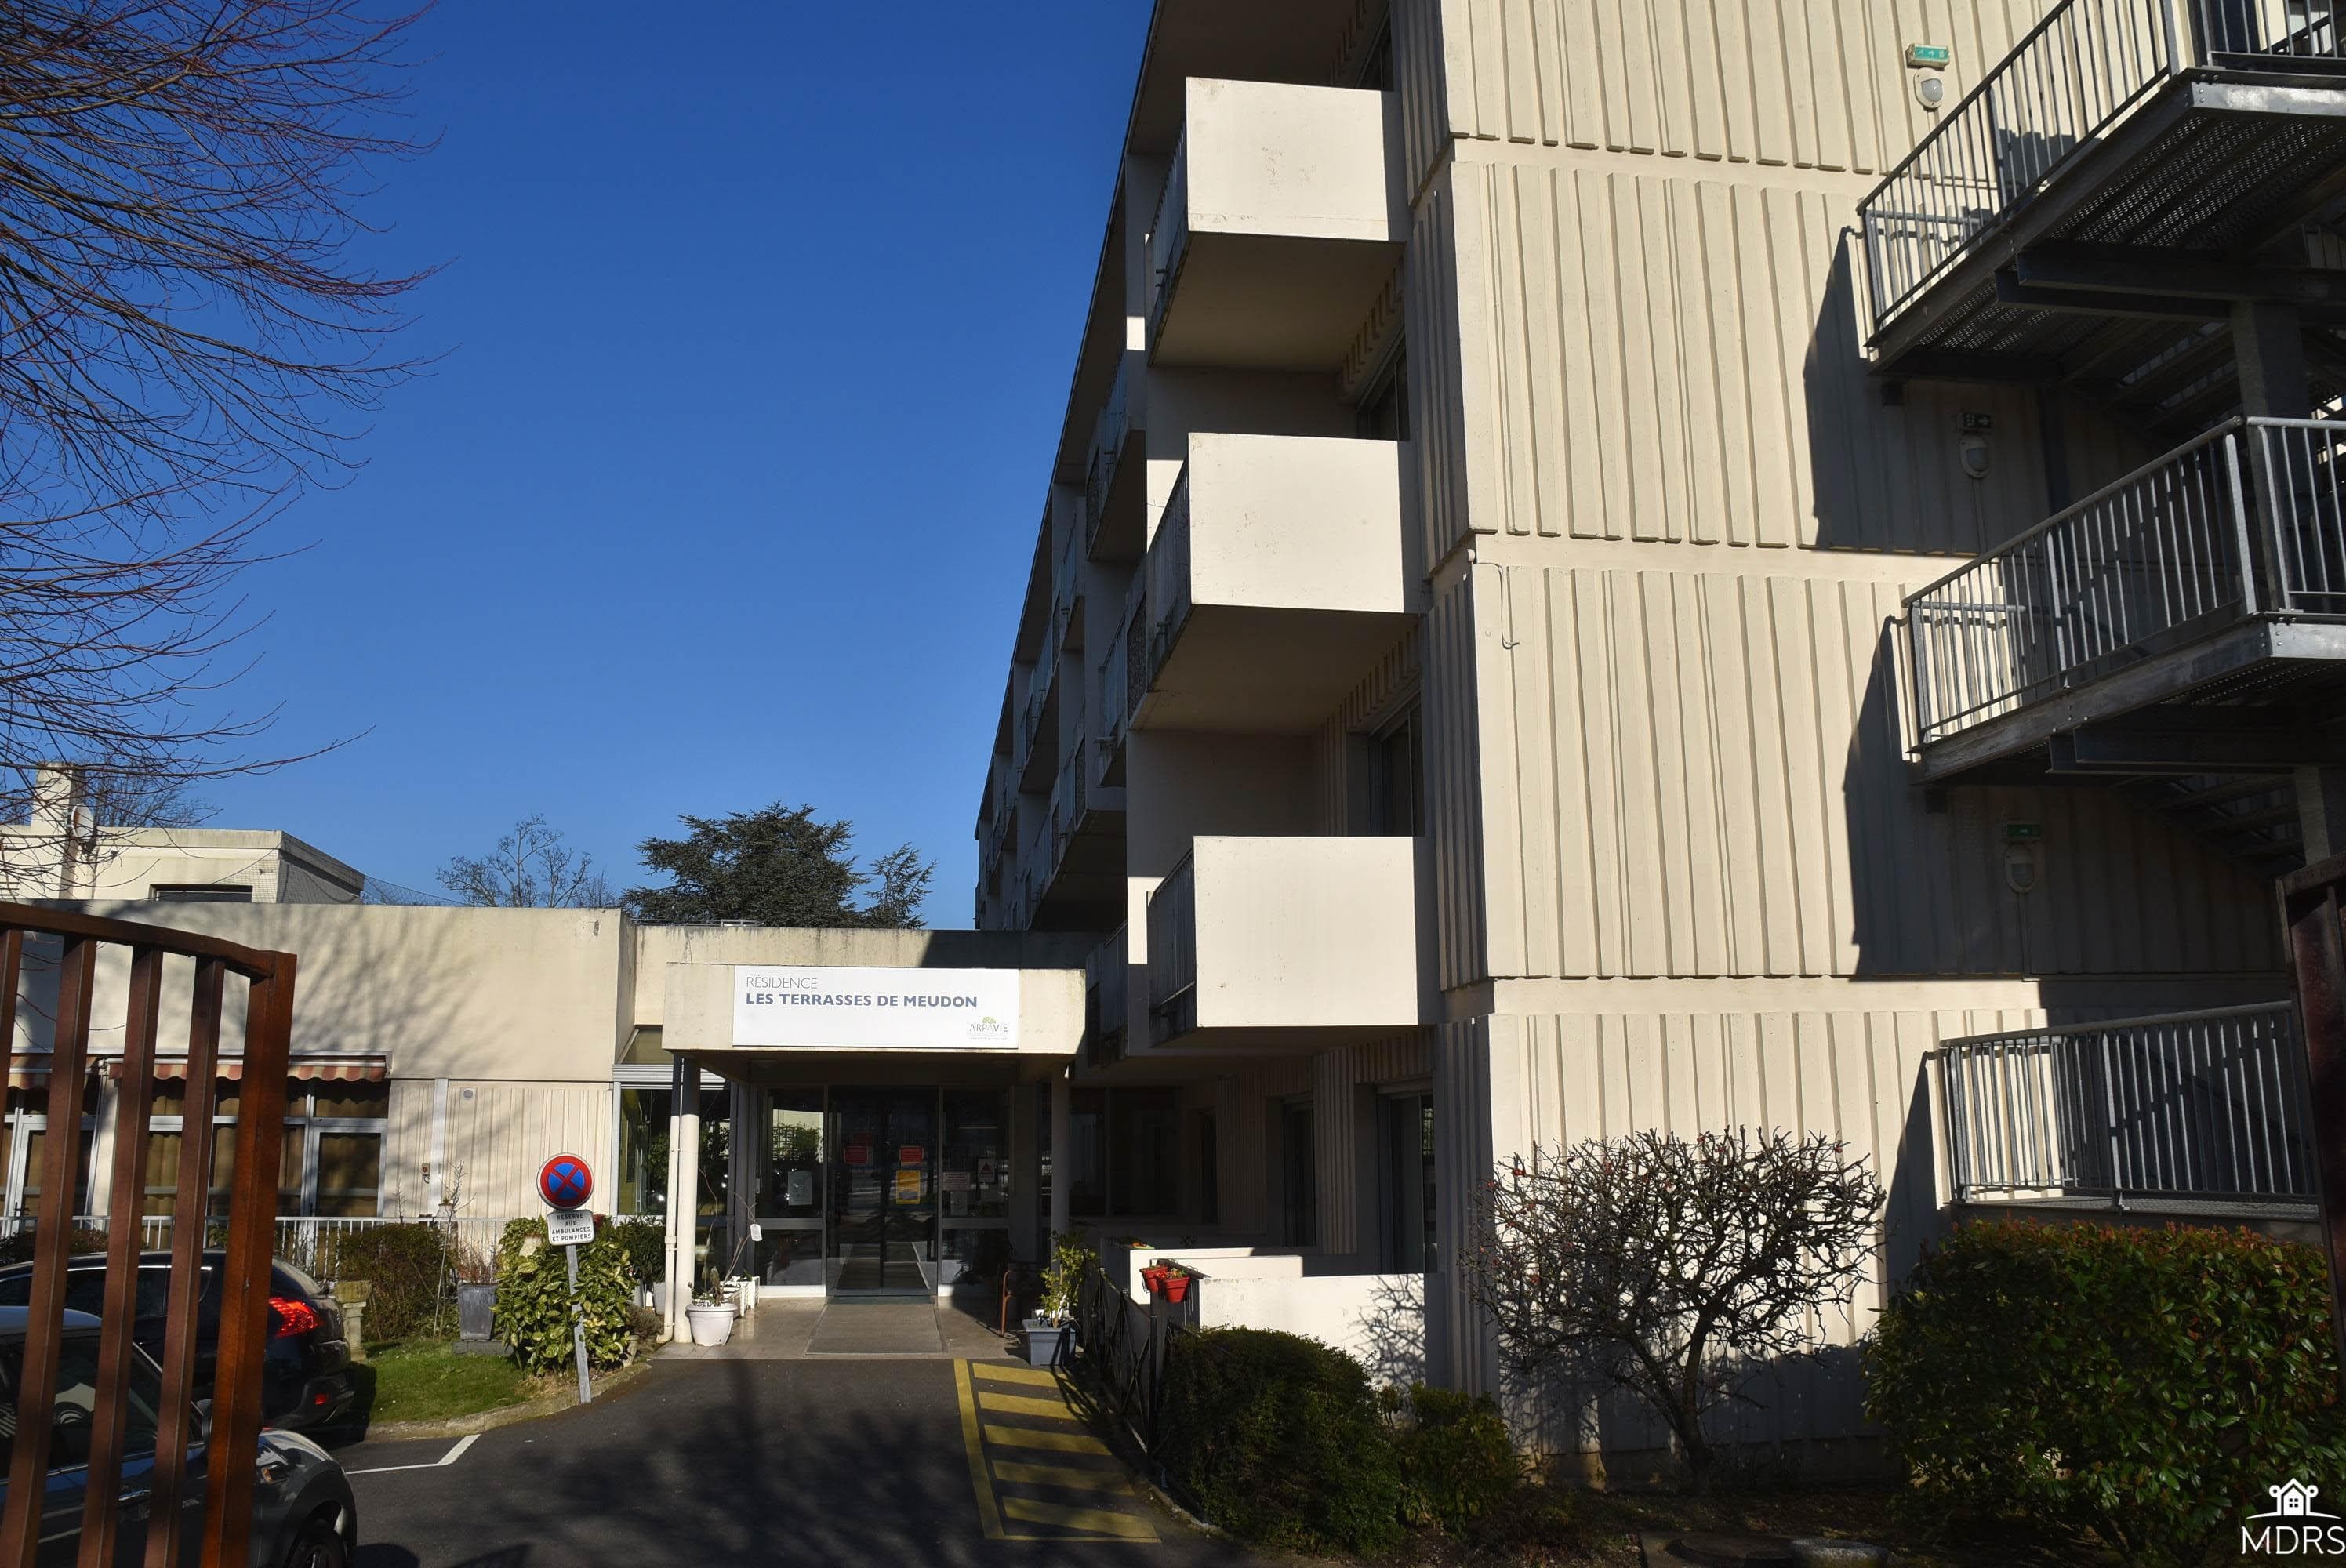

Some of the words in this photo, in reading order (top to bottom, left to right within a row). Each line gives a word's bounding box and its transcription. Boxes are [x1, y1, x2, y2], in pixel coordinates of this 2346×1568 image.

[746, 975, 817, 989] RÉSIDENCE
[746, 993, 774, 1004] LES
[779, 993, 872, 1006] TERRASSES
[877, 995, 899, 1006] DE
[903, 996, 977, 1007] MEUDON
[969, 1023, 1008, 1033] ARPAVIE
